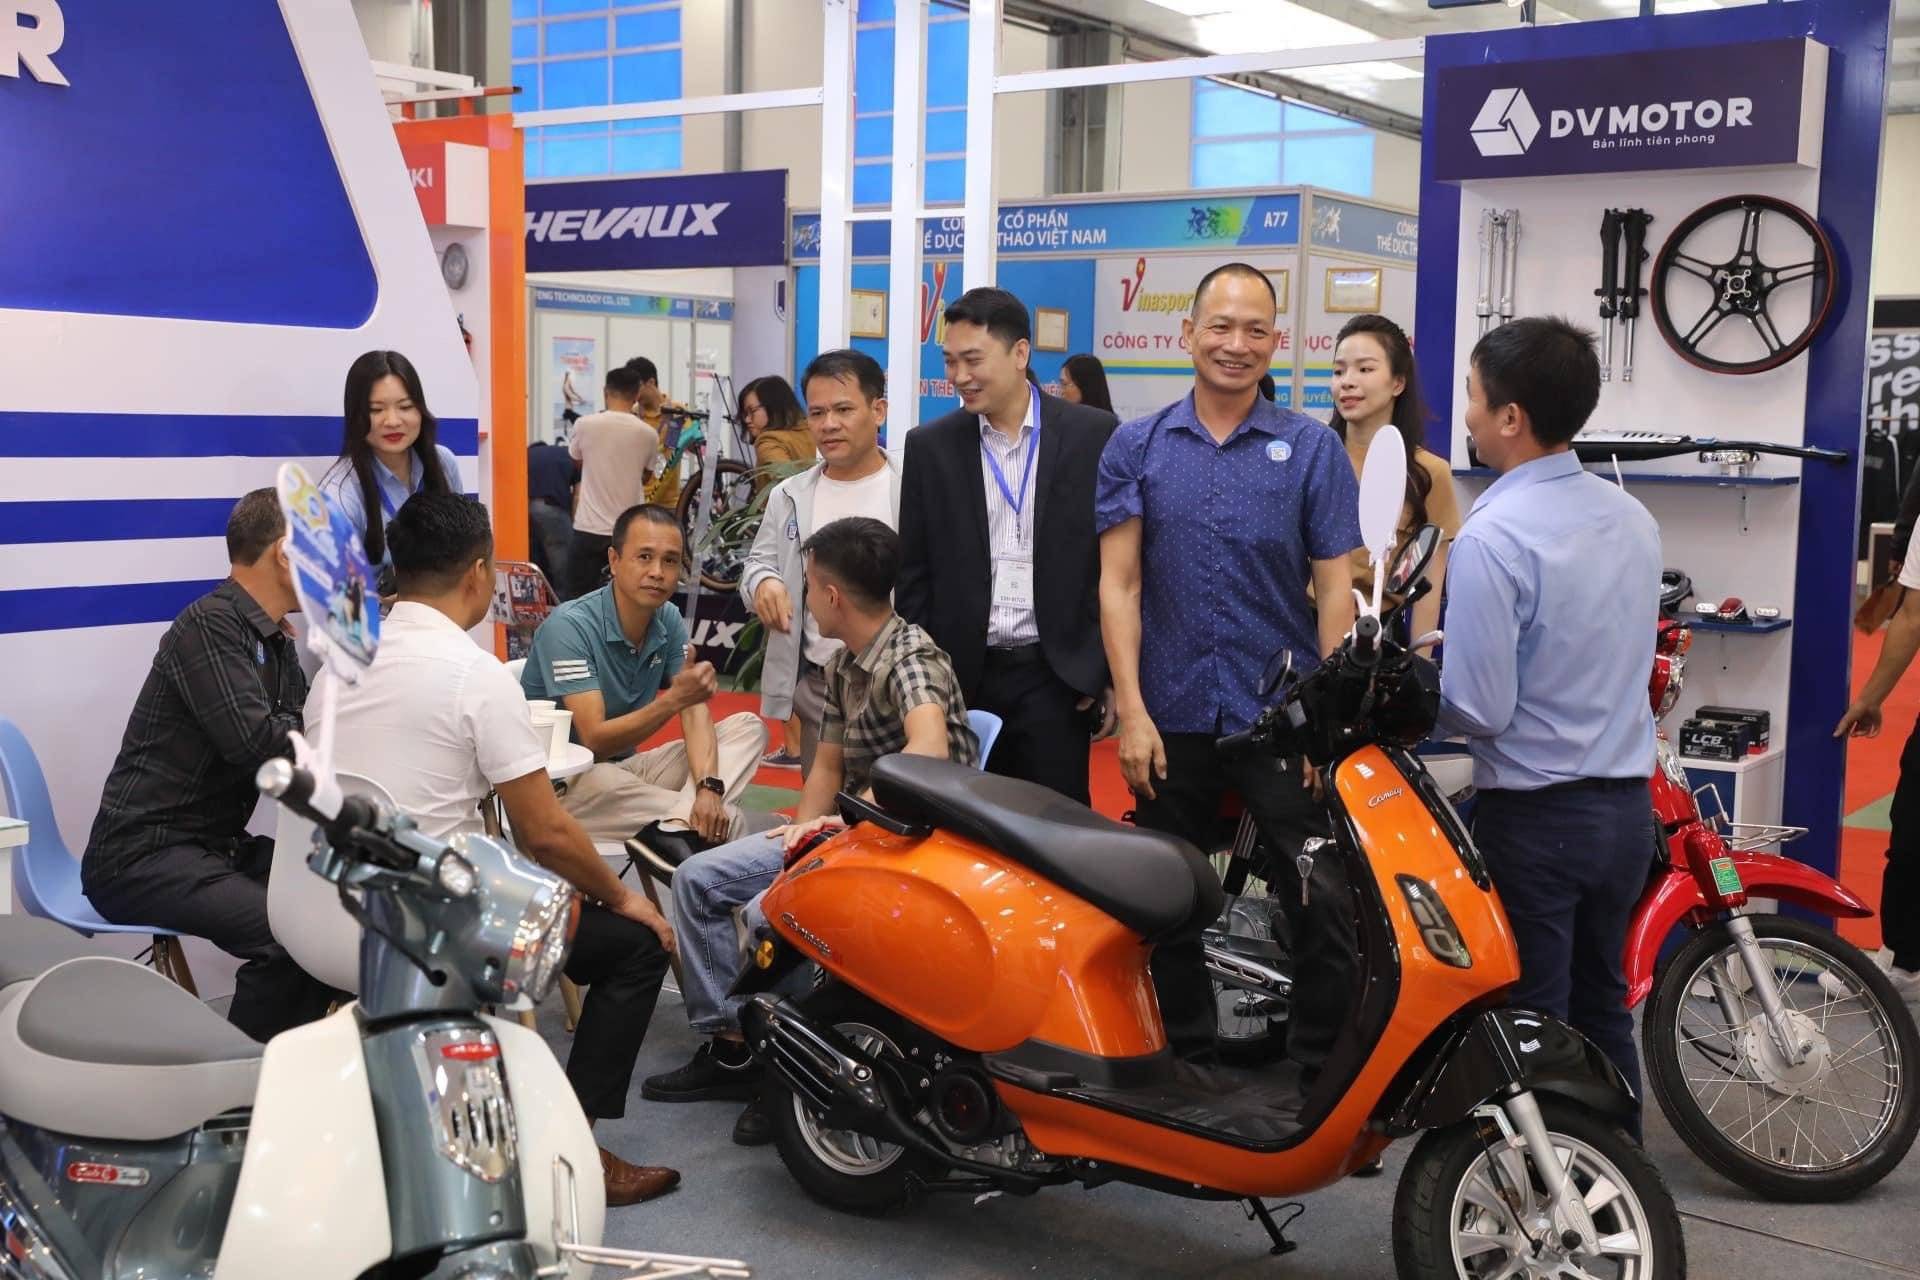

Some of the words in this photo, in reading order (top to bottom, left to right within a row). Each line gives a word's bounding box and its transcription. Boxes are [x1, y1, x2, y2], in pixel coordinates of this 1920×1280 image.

[1550, 97, 1753, 138] DVMOTOR
[1592, 138, 1615, 149] Bản
[1619, 137, 1642, 148] lĩnh
[1647, 135, 1671, 146] tiên
[1675, 134, 1715, 146] phong
[1264, 211, 1288, 228] A77
[1071, 229, 1107, 245] NAM
[1103, 331, 1148, 349] CÔNG
[1153, 335, 1173, 349] TY
